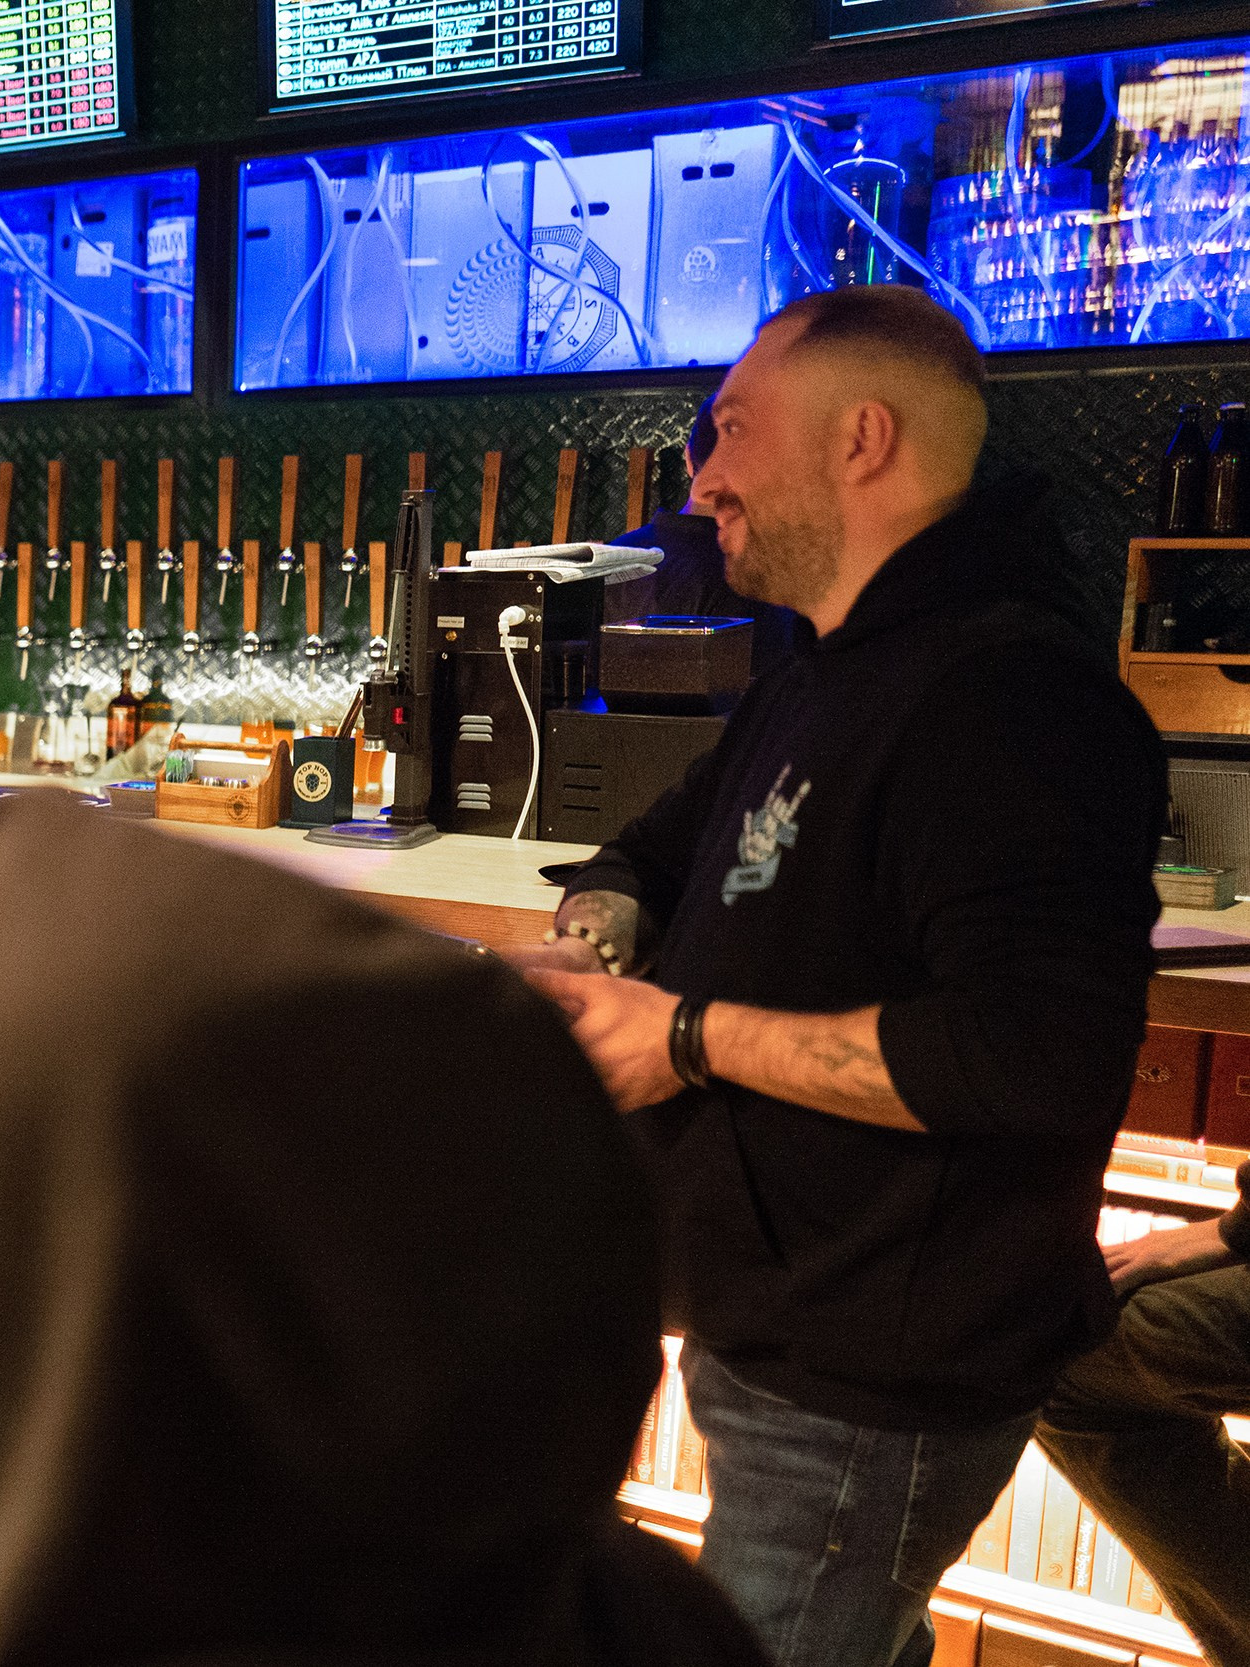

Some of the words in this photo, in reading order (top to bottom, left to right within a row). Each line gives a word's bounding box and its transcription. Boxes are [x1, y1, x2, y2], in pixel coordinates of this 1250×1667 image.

[303, 3, 357, 20] BrewDog
[480, 0, 496, 12] IPA
[589, 1, 612, 14] 420
[529, 11, 543, 22] 6.0
[557, 6, 579, 20] 220
[304, 22, 347, 37] Gletcher
[351, 16, 372, 31] Milk
[376, 13, 388, 27] of
[392, 8, 434, 24] Amnesia
[503, 16, 515, 26] 40
[588, 21, 611, 34] 340
[528, 31, 543, 42] 4.7
[558, 25, 578, 39] 180
[556, 44, 578, 58] 220
[588, 40, 610, 53] 420
[304, 58, 348, 74] Stamm
[353, 51, 380, 67] APA
[437, 62, 451, 72] IPA
[458, 58, 494, 70] American
[503, 54, 514, 64] 70
[338, 67, 393, 84] Отличный
[397, 65, 426, 78] План
[298, 764, 312, 775] TOP
[314, 765, 328, 777] HOP
[1049, 1563, 1064, 1578] 2
